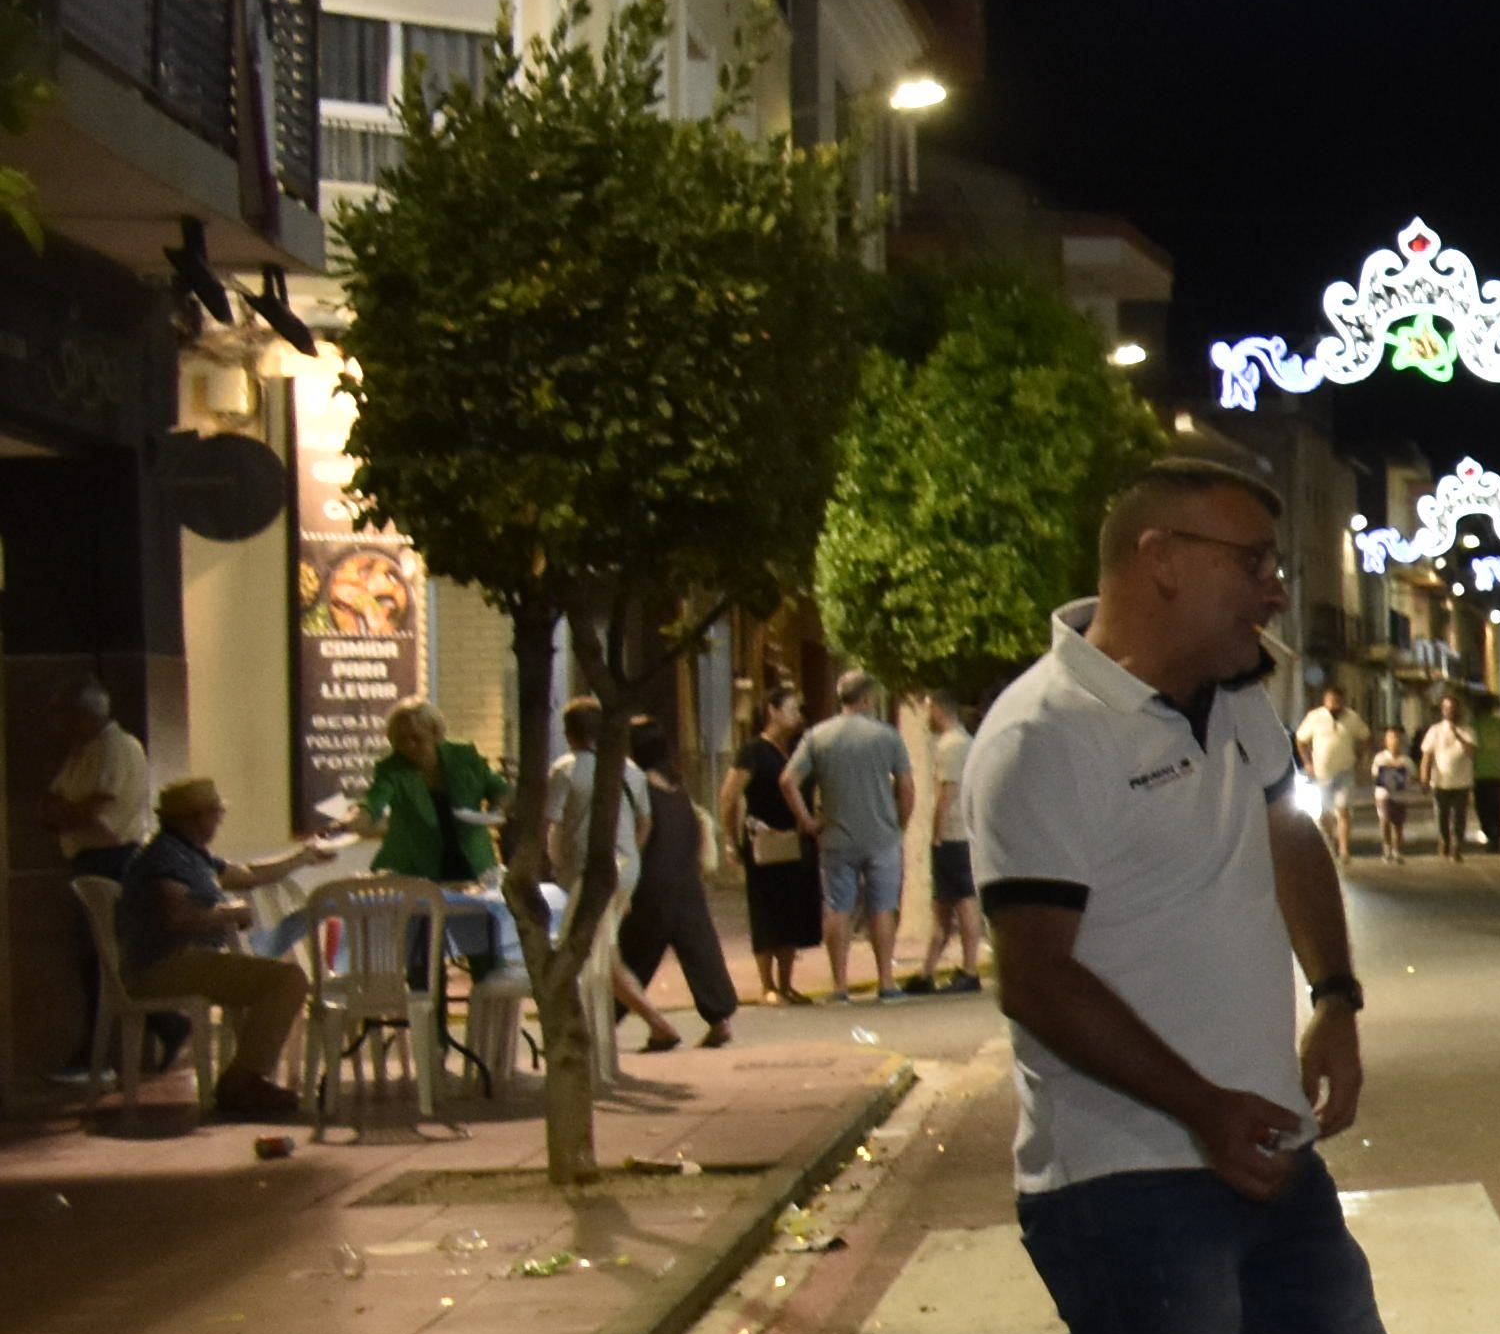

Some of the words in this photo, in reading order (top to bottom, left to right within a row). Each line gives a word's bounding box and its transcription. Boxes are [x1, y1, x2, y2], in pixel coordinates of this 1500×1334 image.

[320, 639, 399, 659] COMIDA
[331, 660, 388, 679] PARA
[320, 681, 398, 700] LLEVAR
